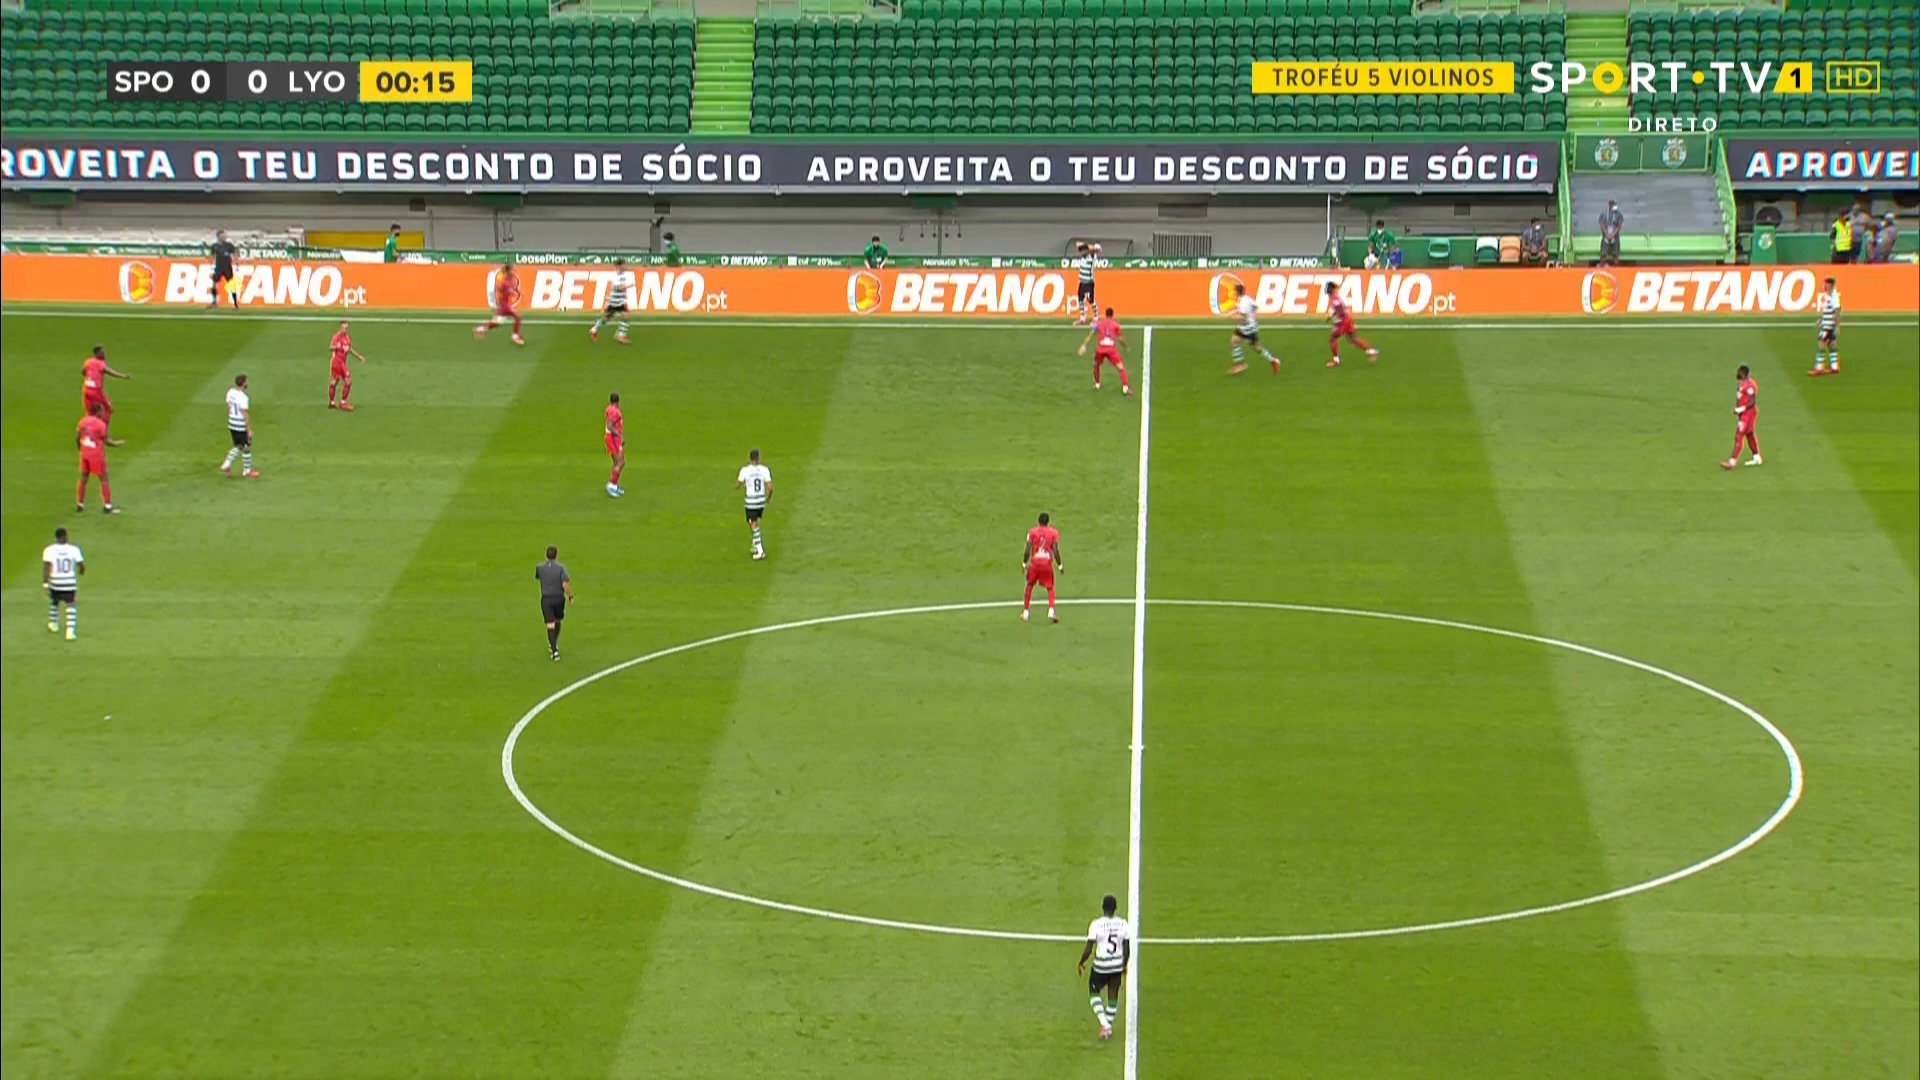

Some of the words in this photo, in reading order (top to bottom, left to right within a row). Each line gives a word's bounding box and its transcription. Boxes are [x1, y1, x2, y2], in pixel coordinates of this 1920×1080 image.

[193, 150, 220, 180] O
[238, 151, 317, 181] TEU
[337, 151, 554, 181] DESCONTO
[574, 153, 623, 181] DE
[642, 143, 762, 182] SÓCIO
[807, 156, 1013, 182] APROVEITA
[1030, 157, 1051, 182] O
[1068, 156, 1136, 182] TEU
[1154, 155, 1347, 181] DESCONTO
[1364, 156, 1409, 181] DE
[1427, 146, 1539, 181] SÓCIO
[516, 253, 568, 264] LeasePlan
[891, 273, 1082, 314] BETANO.p
[56, 558, 71, 574] 10
[1107, 934, 1118, 955] 5
